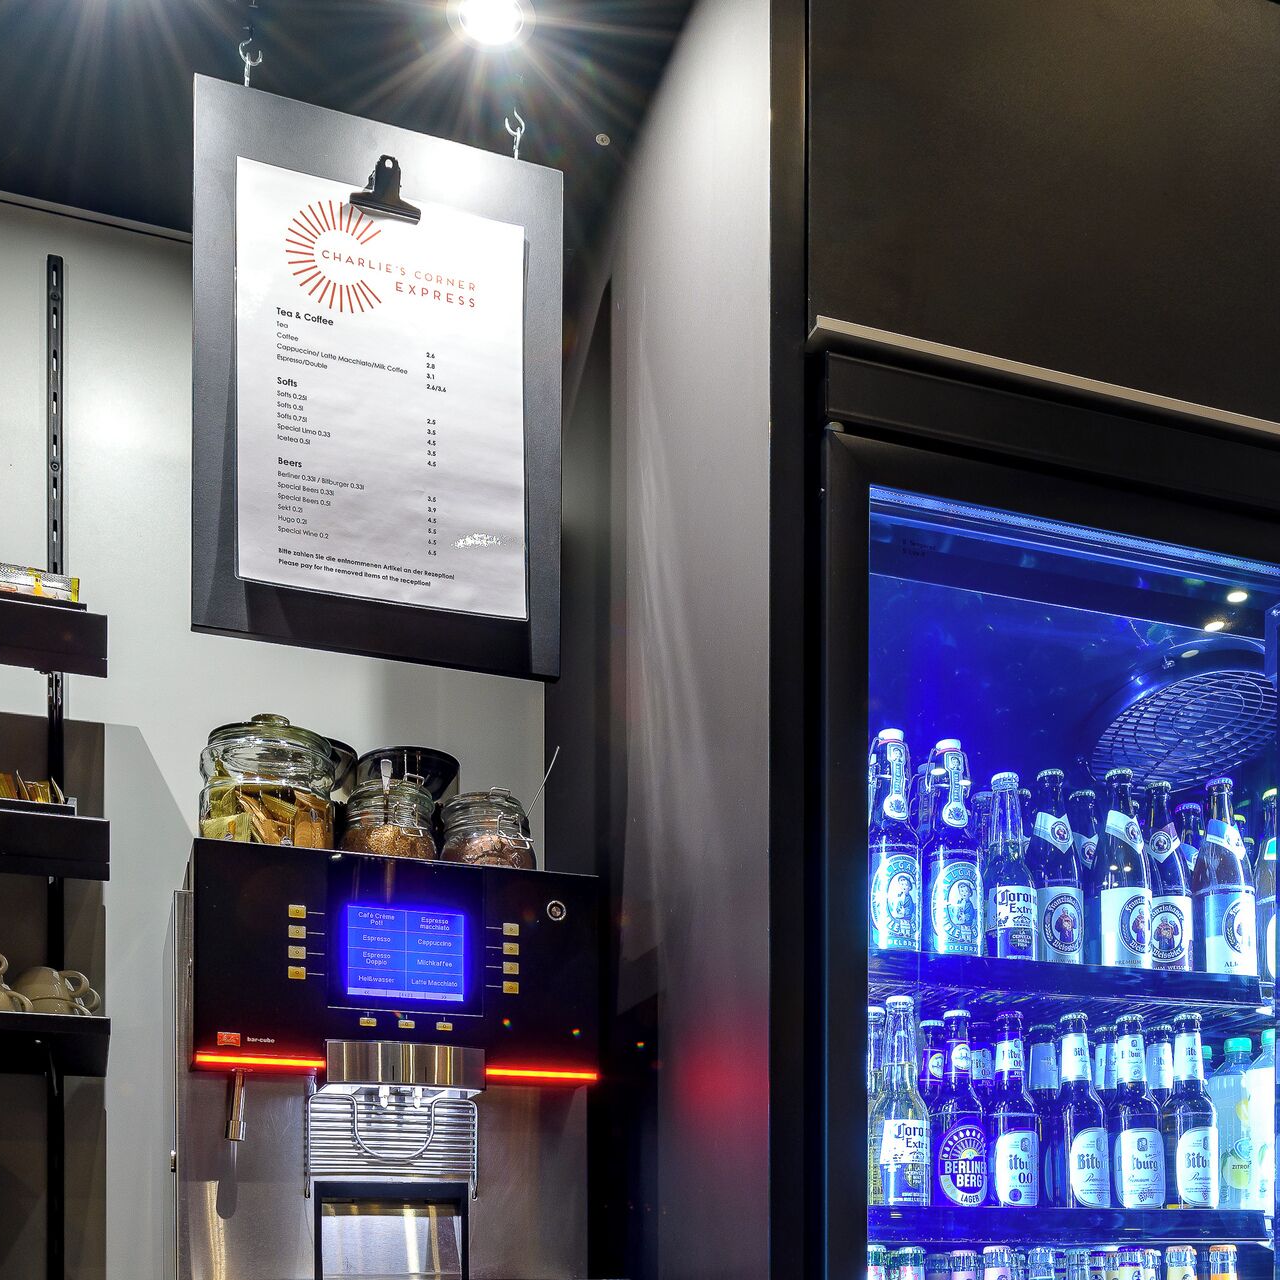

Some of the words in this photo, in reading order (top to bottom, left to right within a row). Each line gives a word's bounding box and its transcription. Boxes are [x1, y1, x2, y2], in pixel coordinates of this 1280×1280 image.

[322, 250, 406, 276] CHARLIE'S
[415, 271, 476, 292] CORNER
[395, 281, 476, 309] EXPRESS
[277, 307, 293, 318] Tea
[296, 312, 302, 320] &
[304, 313, 334, 326] Coffee
[276, 321, 289, 329] Tea
[276, 332, 299, 342] Coffee
[276, 342, 319, 357] Cappuccino/
[321, 352, 337, 361] Latte
[338, 355, 386, 370] Macchiato/Milk
[387, 365, 408, 375] Coffee
[276, 354, 328, 370] Espresso/Double
[277, 376, 298, 388] Softs
[277, 401, 292, 410] Softs
[277, 390, 292, 400] Softs
[427, 418, 436, 426] 2.5
[277, 412, 292, 421] Softs
[427, 439, 436, 447] 4.5
[277, 423, 301, 434] Special
[302, 427, 317, 436] Limo
[318, 430, 331, 438] 0.33
[277, 434, 299, 444] Icetea
[427, 460, 437, 468] 4.5
[278, 456, 303, 469] Beers
[278, 471, 301, 481] Berliner
[322, 477, 349, 489] Bitburger
[278, 482, 301, 492] Special
[302, 485, 319, 494] Beers
[278, 492, 301, 502] Special
[302, 496, 319, 505] Beers
[278, 503, 292, 513] Sekt
[278, 515, 296, 524] Hugo
[278, 525, 301, 535] Special
[303, 529, 319, 538] Wine
[319, 532, 329, 540] 0.2
[278, 548, 292, 556] Bitte
[293, 550, 314, 559] zahlen
[315, 553, 325, 561] Sie
[338, 558, 382, 570] entnommenen
[383, 565, 403, 573] Artikel
[424, 570, 455, 581] Rezeption!
[278, 559, 299, 568] Please
[301, 562, 313, 570] pay
[335, 568, 363, 577] removed
[364, 571, 381, 580] items
[390, 575, 399, 583] the
[400, 578, 431, 587] reception!
[421, 917, 449, 925] Espresso
[362, 935, 391, 943] Espresso
[418, 939, 452, 947] Cappuccino
[366, 958, 388, 966] Doppio
[417, 959, 453, 968] Milchkaffee
[428, 980, 458, 988] Macchiato
[956, 1174, 983, 1188] BERG
[1018, 1174, 1033, 1184] 0.0
[960, 1194, 981, 1204] LAGER
